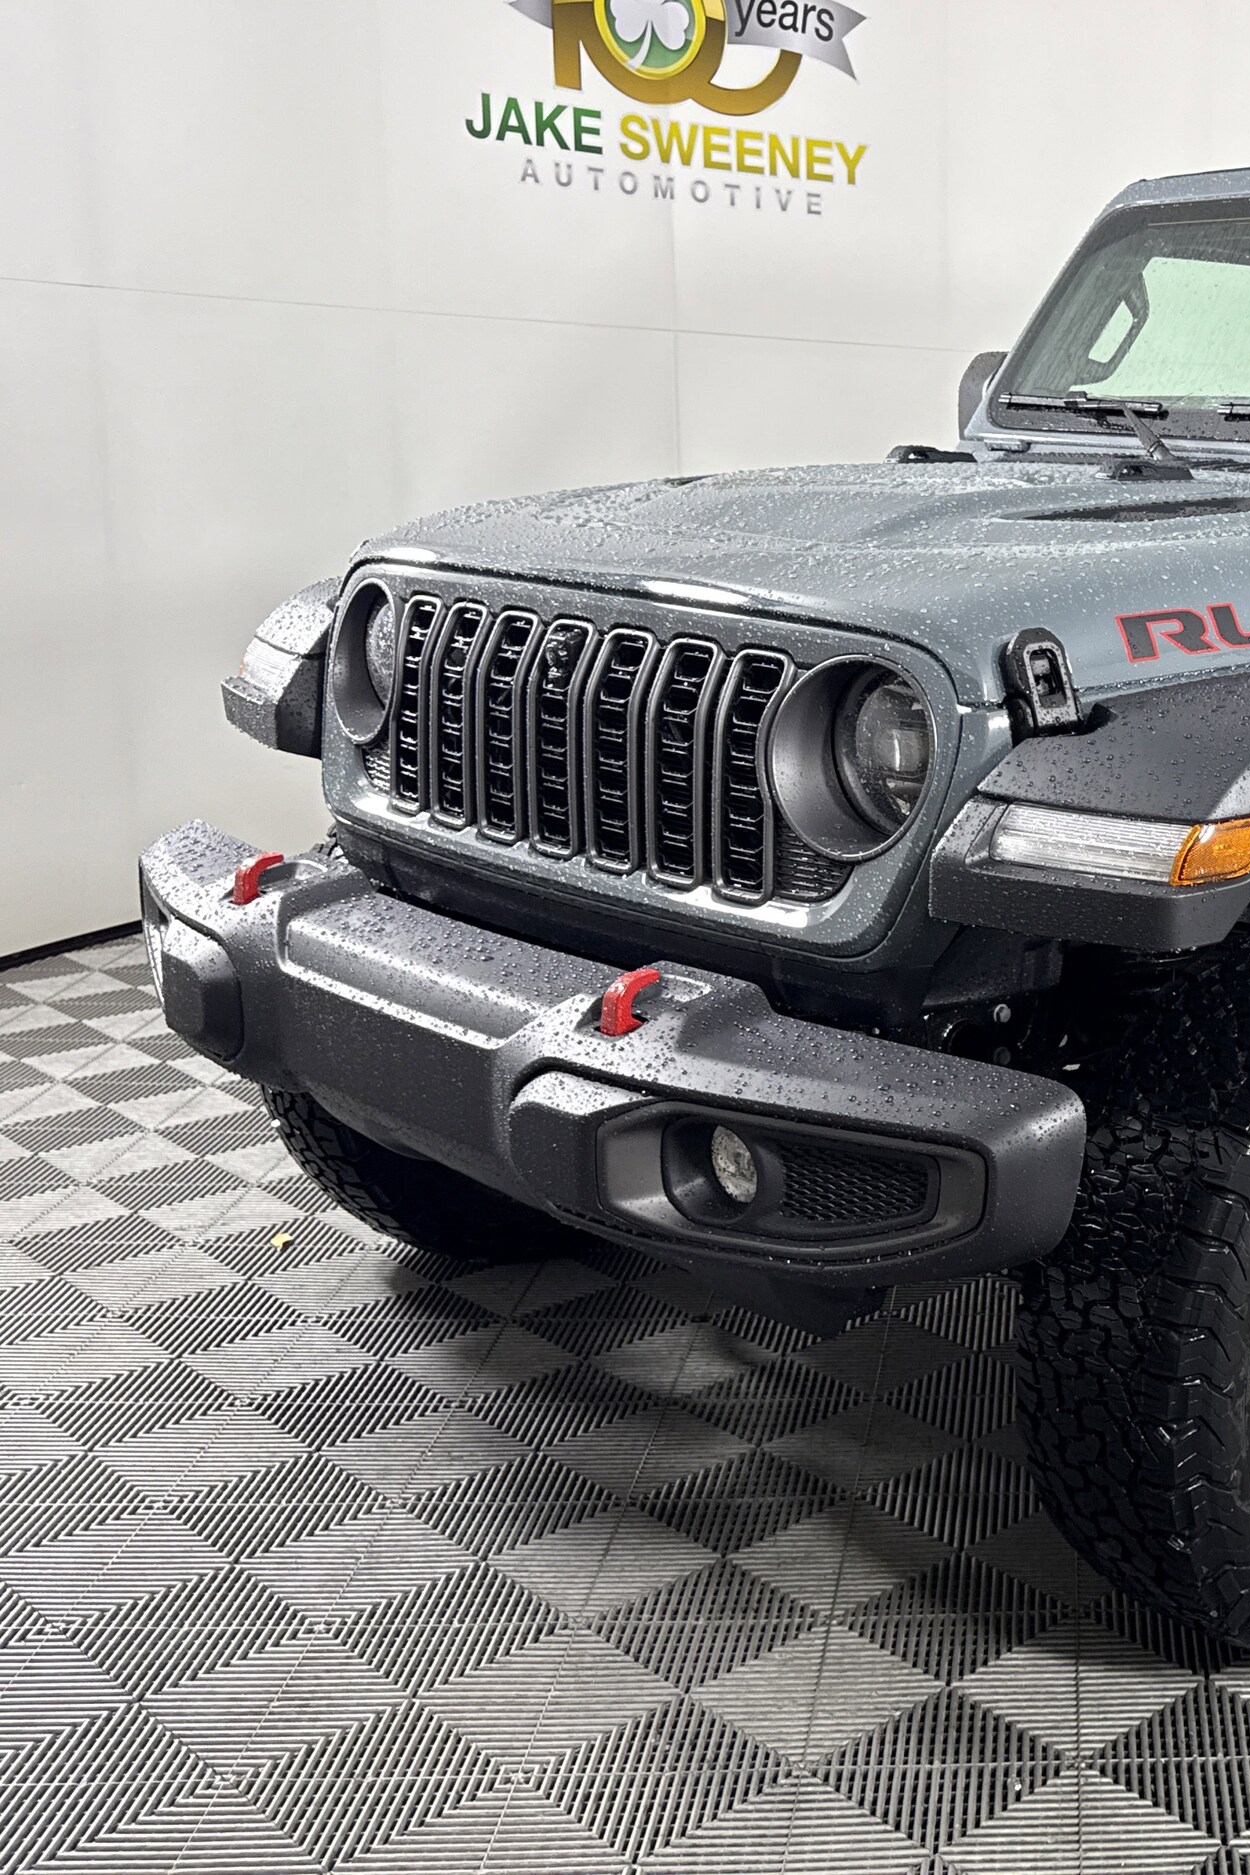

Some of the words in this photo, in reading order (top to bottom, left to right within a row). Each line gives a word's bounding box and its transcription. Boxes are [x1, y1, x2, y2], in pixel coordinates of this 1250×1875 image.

[735, 0, 835, 41] years
[465, 92, 603, 155] JAKE
[619, 114, 868, 185] SWEENEY
[519, 158, 823, 215] AUTOMOTIVE
